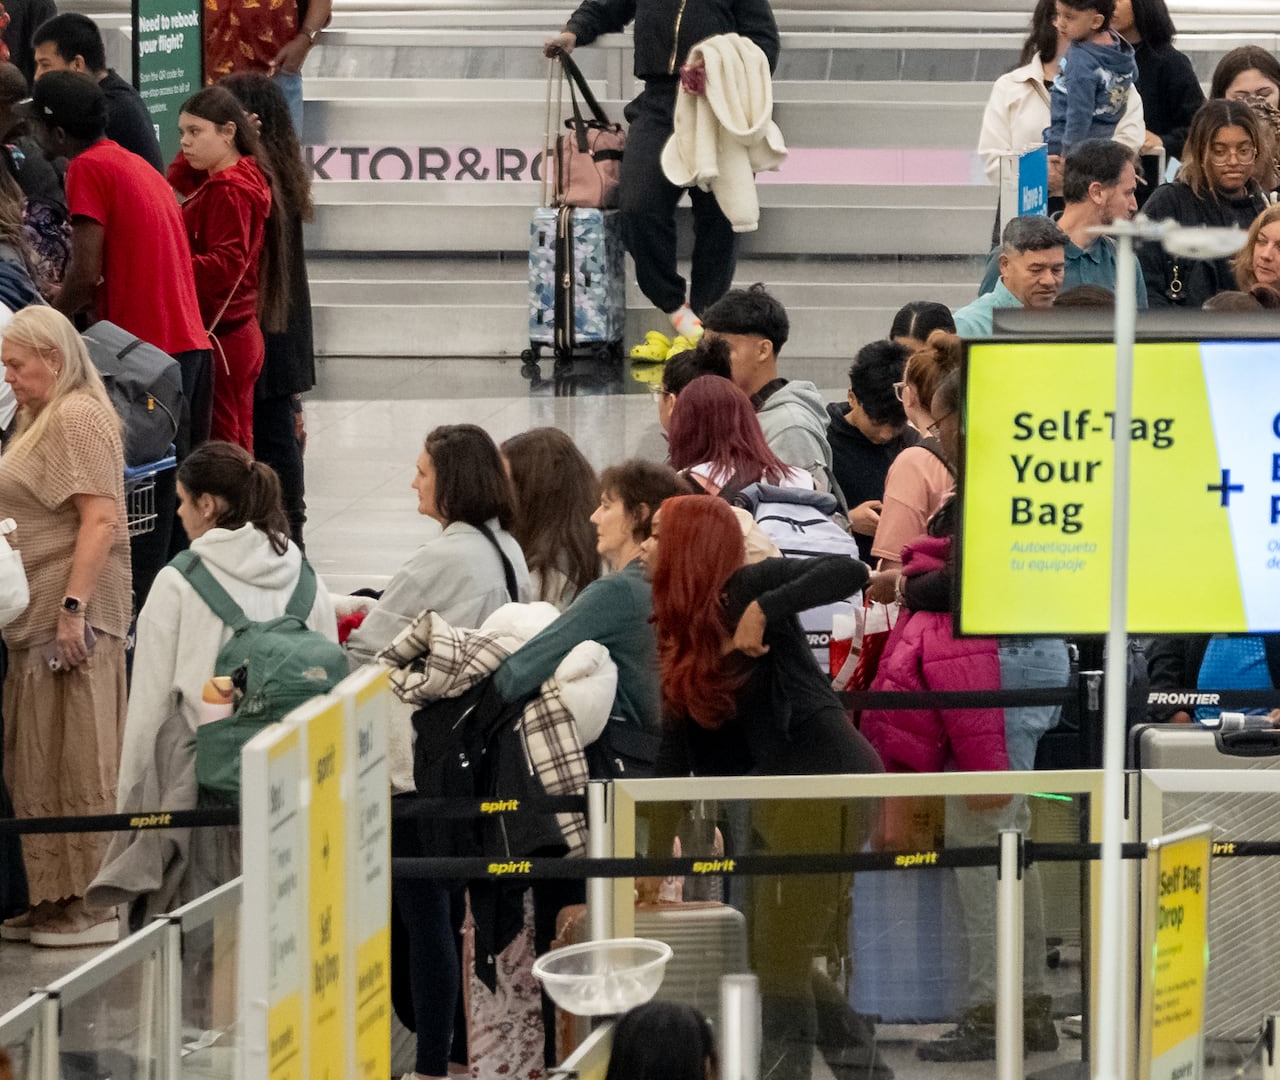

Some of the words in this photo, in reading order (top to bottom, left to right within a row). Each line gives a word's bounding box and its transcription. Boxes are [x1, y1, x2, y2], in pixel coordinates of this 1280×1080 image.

[139, 14, 160, 34] Need
[162, 14, 170, 30] to
[171, 10, 199, 30] rebook
[139, 38, 158, 58] your
[158, 33, 184, 54] flight?
[1010, 454, 1102, 485] Your
[1010, 496, 1085, 535] Bag
[1010, 540, 1098, 558] Autoetiqueta
[1010, 557, 1027, 571] tu
[1030, 557, 1086, 572] equipaje
[1148, 692, 1220, 706] FRONTIER
[480, 799, 520, 816] spirit
[129, 813, 171, 830] spirit
[1212, 841, 1236, 855] irit
[692, 859, 736, 875] spirit
[895, 851, 938, 868] spirit
[487, 860, 532, 877] spirit
[1160, 867, 1181, 897] Self
[1183, 864, 1202, 895] Bag
[1157, 904, 1185, 933] Drop
